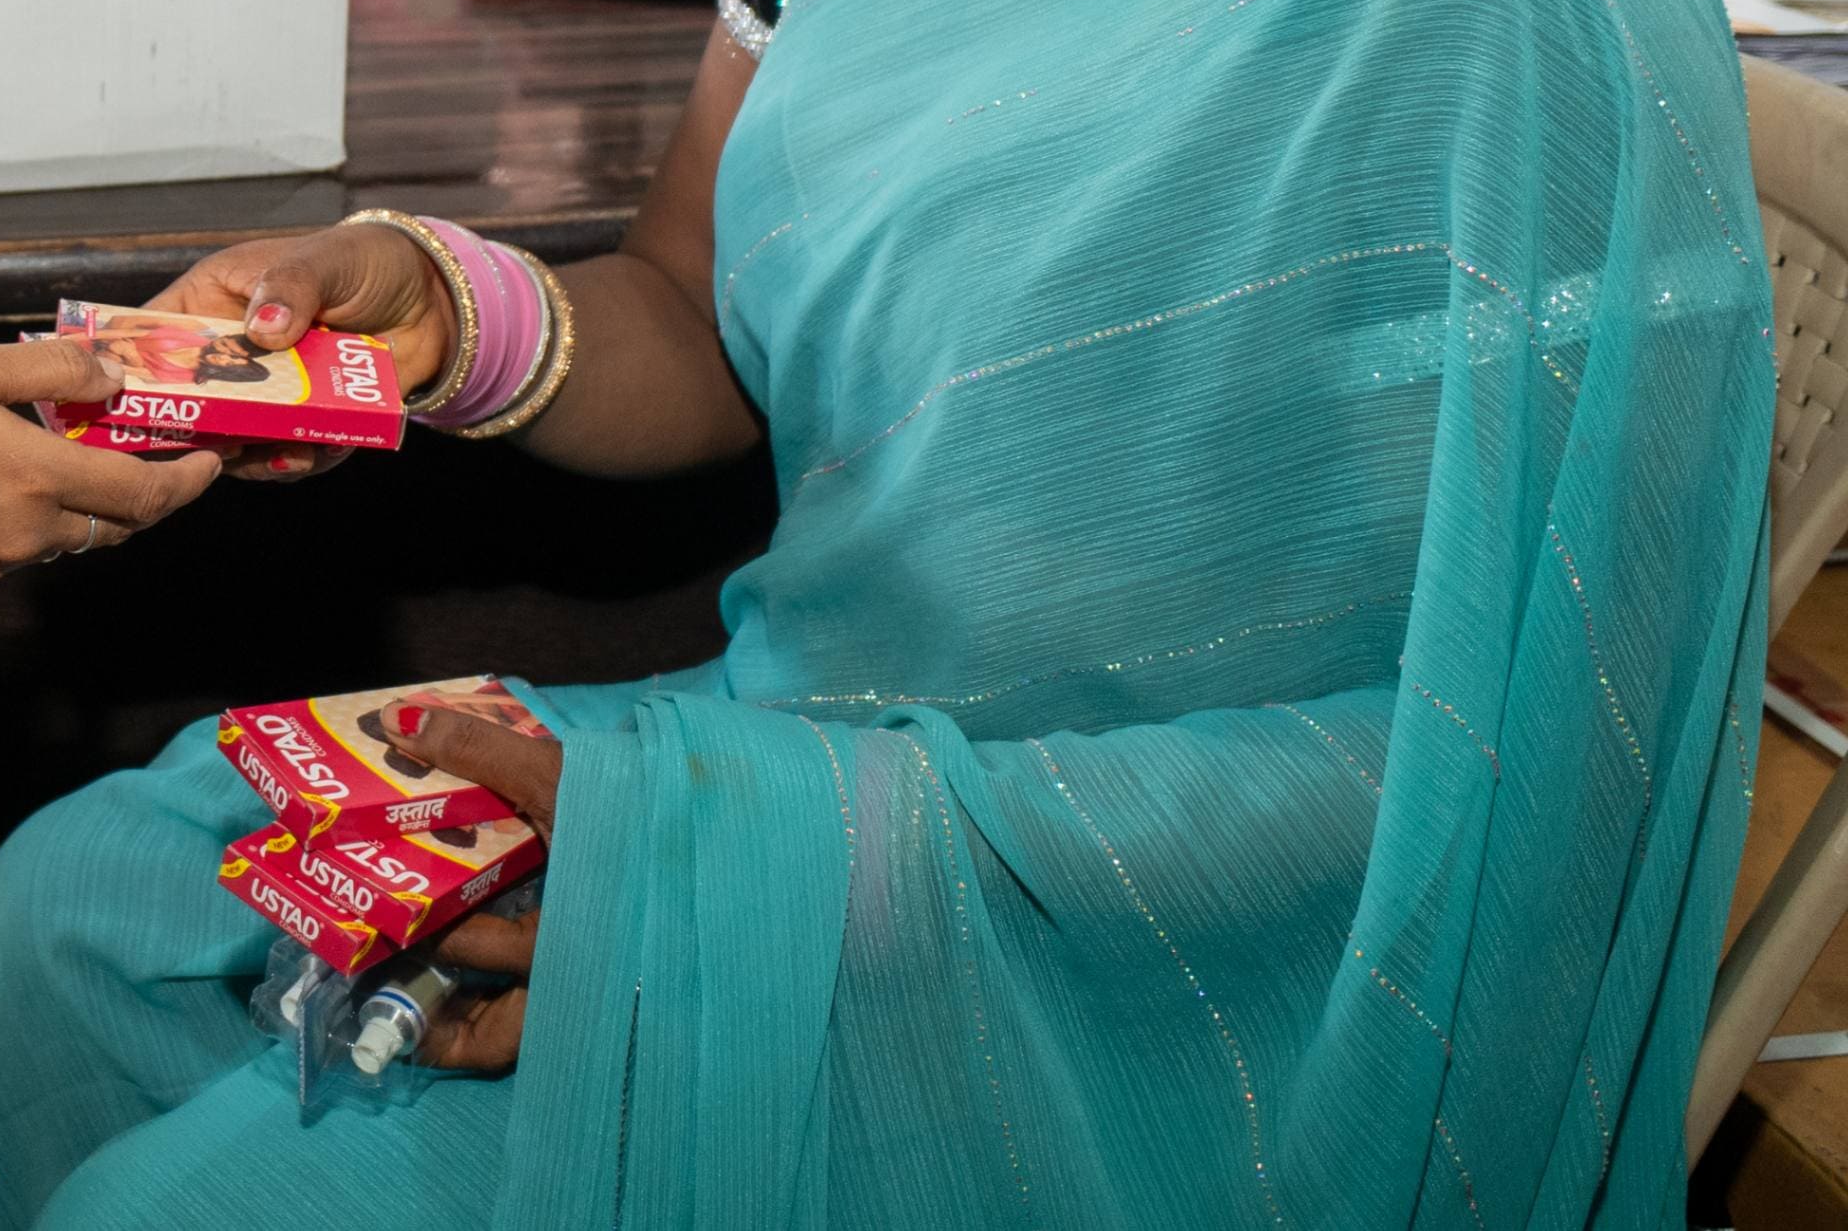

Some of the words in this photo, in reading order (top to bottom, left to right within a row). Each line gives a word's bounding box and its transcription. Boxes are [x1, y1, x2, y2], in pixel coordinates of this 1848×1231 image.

[336, 338, 382, 403] USTAD
[105, 394, 201, 422] USTAD
[148, 418, 194, 429] CONDOMS
[309, 429, 323, 439] For
[325, 431, 348, 442] single
[350, 434, 364, 442] use
[366, 435, 386, 446] only.
[256, 714, 350, 800] USTAD
[286, 716, 327, 757] CONDOMS
[238, 745, 289, 810] USTAD
[386, 798, 448, 824] उस्ताद
[299, 851, 374, 913] USTAD
[250, 877, 320, 941] USTAD
